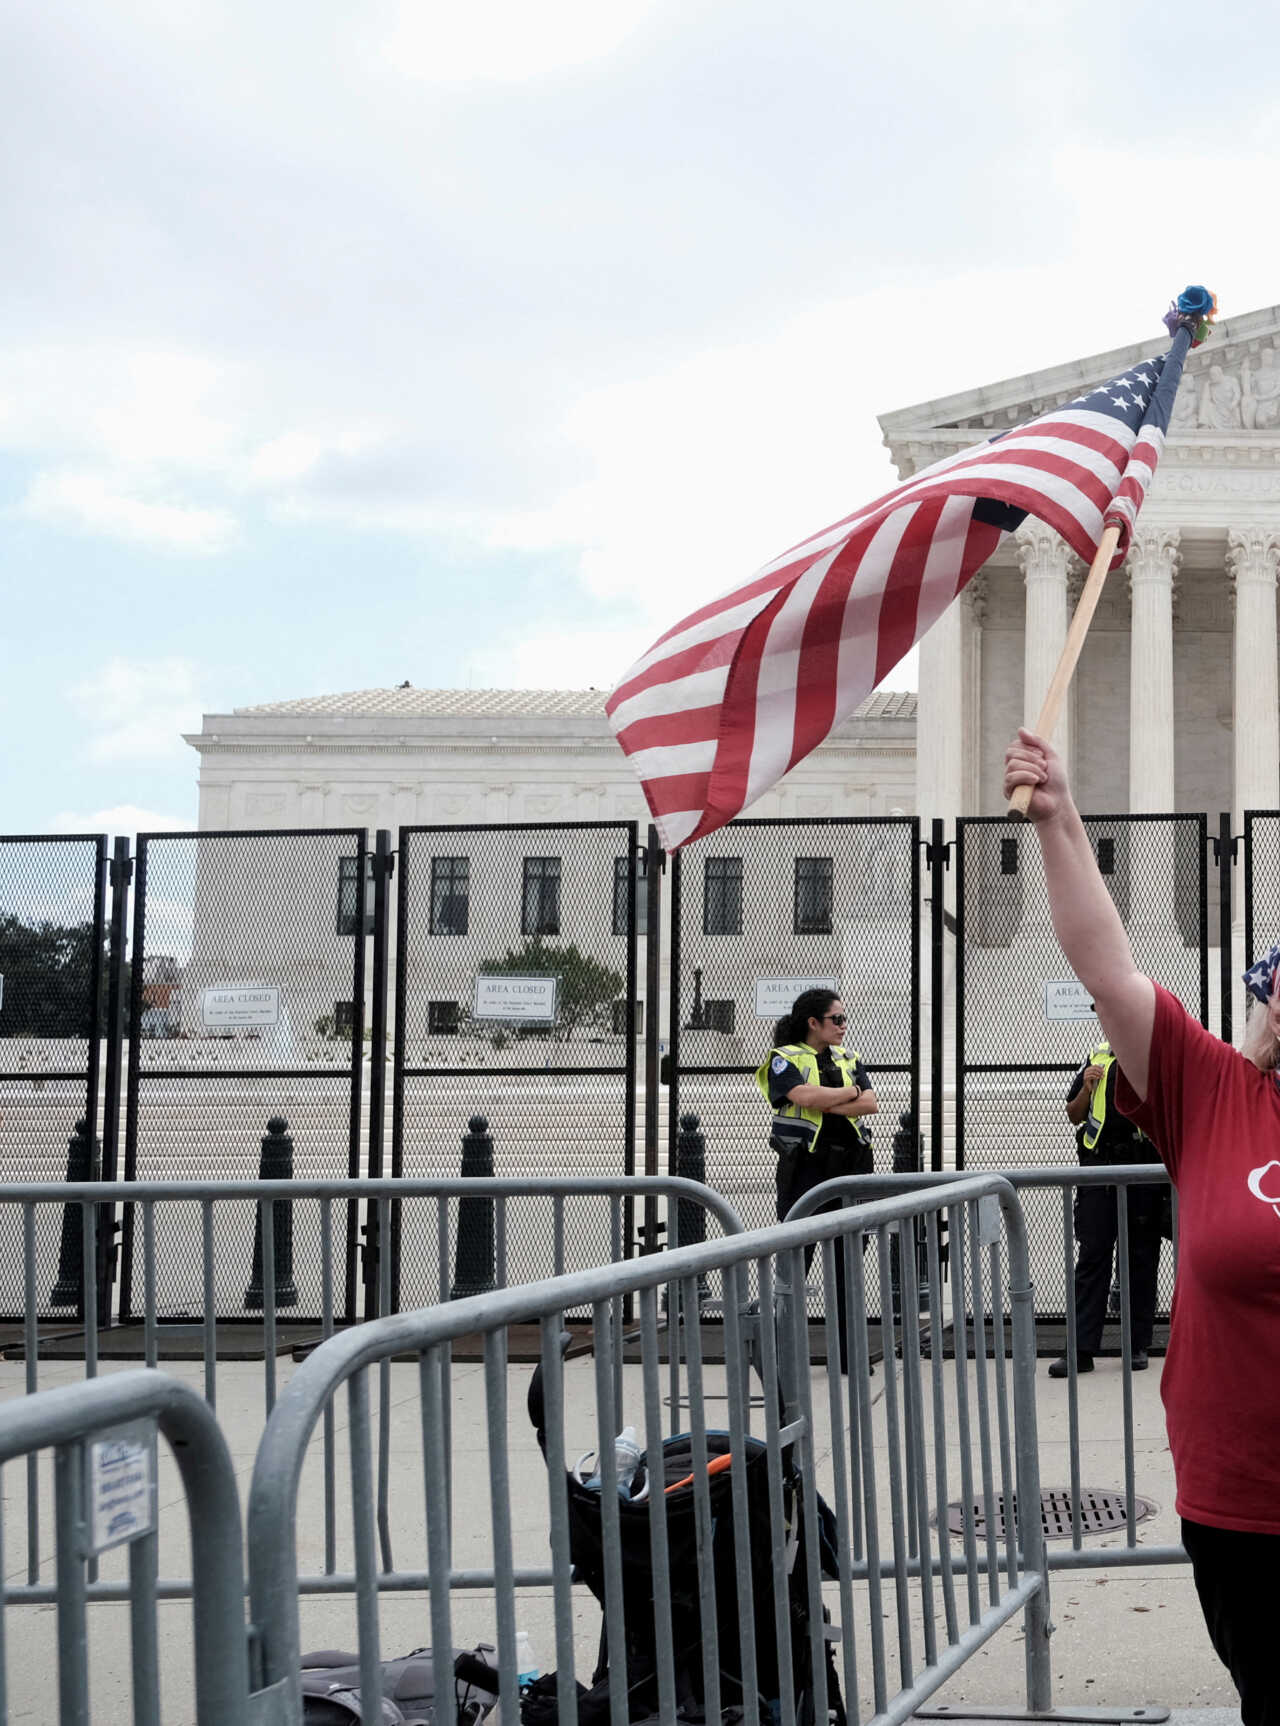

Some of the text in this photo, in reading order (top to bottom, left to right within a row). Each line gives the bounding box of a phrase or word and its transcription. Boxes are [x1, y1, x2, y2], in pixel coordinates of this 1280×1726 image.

[1167, 474, 1241, 491] EQUAL
[486, 984, 546, 994] AREA CLOSED
[765, 984, 790, 993] AREA
[1055, 988, 1080, 996] AREA
[212, 993, 272, 1003] AREA CLOSED
